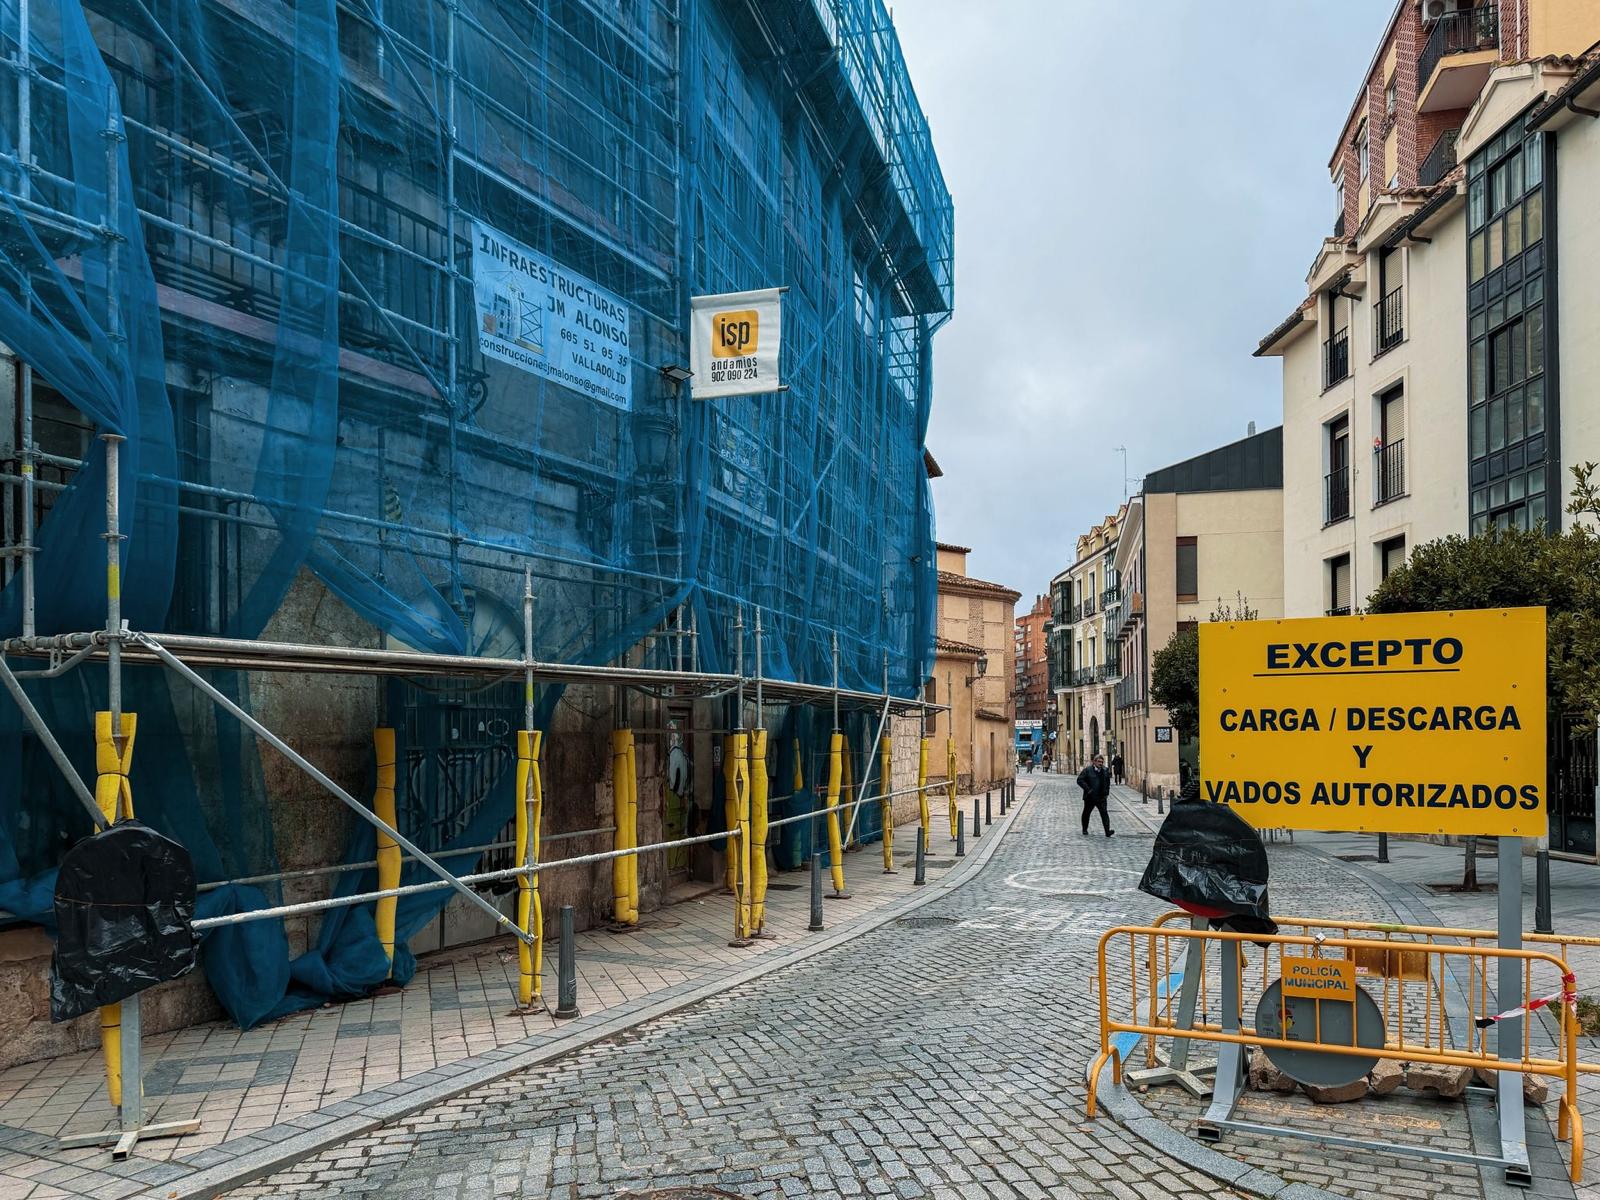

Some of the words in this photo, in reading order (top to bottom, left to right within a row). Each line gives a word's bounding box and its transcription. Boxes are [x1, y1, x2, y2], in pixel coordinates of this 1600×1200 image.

[479, 232, 625, 323] INFRAESTRUCTURAS
[547, 295, 566, 318] JM
[575, 309, 628, 347] ALONSO
[720, 317, 750, 350] isp
[583, 339, 596, 353] 51
[601, 348, 613, 360] 05
[617, 353, 628, 368] 35
[711, 356, 758, 371] andamios
[572, 352, 627, 385] VALLADOLID
[711, 370, 726, 382] 902
[727, 369, 742, 381] 090
[743, 367, 758, 380] 224
[1267, 637, 1463, 669] EXCEPTO
[1220, 708, 1320, 732] CARGA
[1329, 708, 1336, 731] /
[1347, 705, 1521, 731] DESCARGA
[1352, 745, 1373, 769] Y
[1205, 780, 1300, 805] VADOS
[1310, 782, 1540, 810] AUTORIZADOS
[1284, 976, 1349, 991] MUNICIPAL
[1292, 964, 1342, 977] POLICÍA
